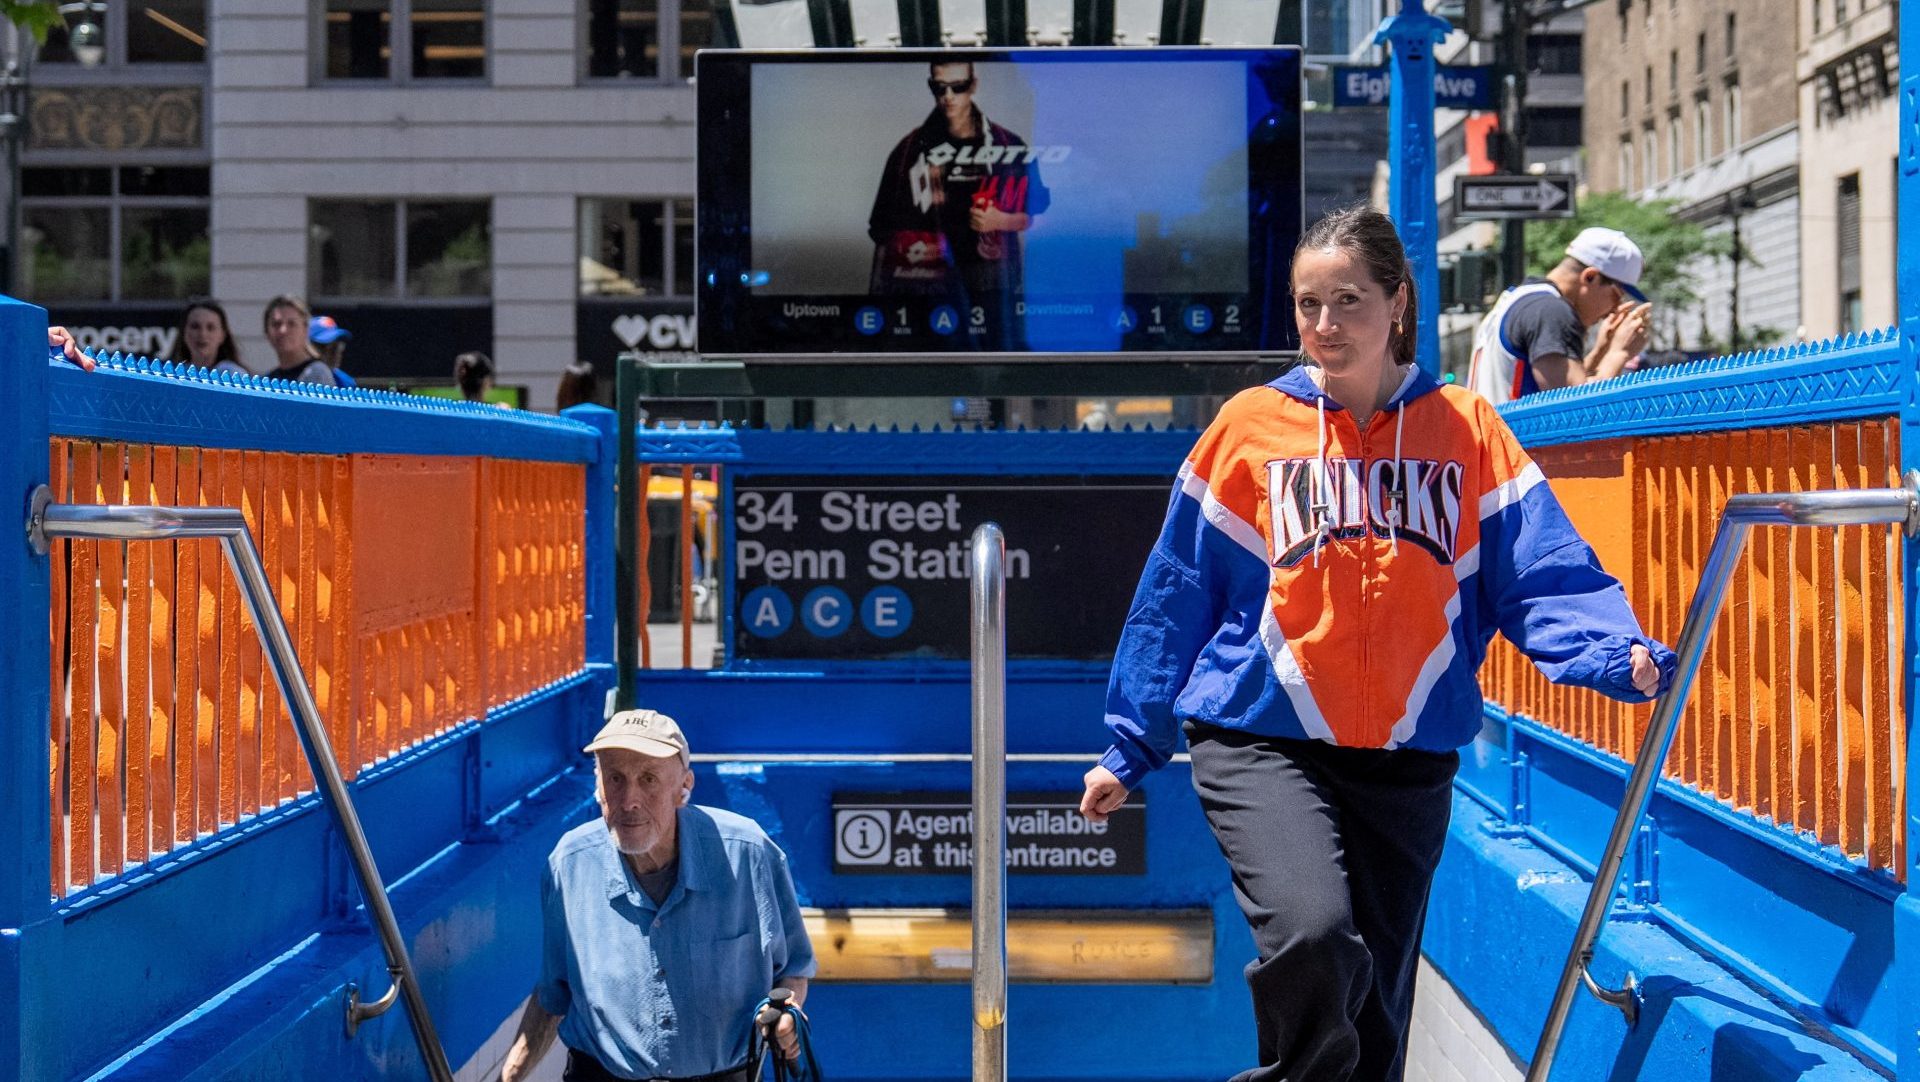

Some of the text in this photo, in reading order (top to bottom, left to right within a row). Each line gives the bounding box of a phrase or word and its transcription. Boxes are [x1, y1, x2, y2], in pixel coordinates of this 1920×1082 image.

[1347, 73, 1476, 102] Eig Ave
[955, 145, 1072, 164] LOTTO
[1474, 187, 1555, 201] ONE WAY
[783, 302, 1239, 328] Uptown E 1 A 3 Downtown A 1 E 2
[68, 326, 179, 361] ocery
[649, 314, 698, 349] CV
[736, 491, 961, 532] 34 Street
[1265, 457, 1464, 567] KNICKS
[736, 539, 1031, 580] Penn Statin
[754, 596, 898, 628] A C E
[1005, 809, 1108, 835] vailable
[894, 843, 923, 867] at
